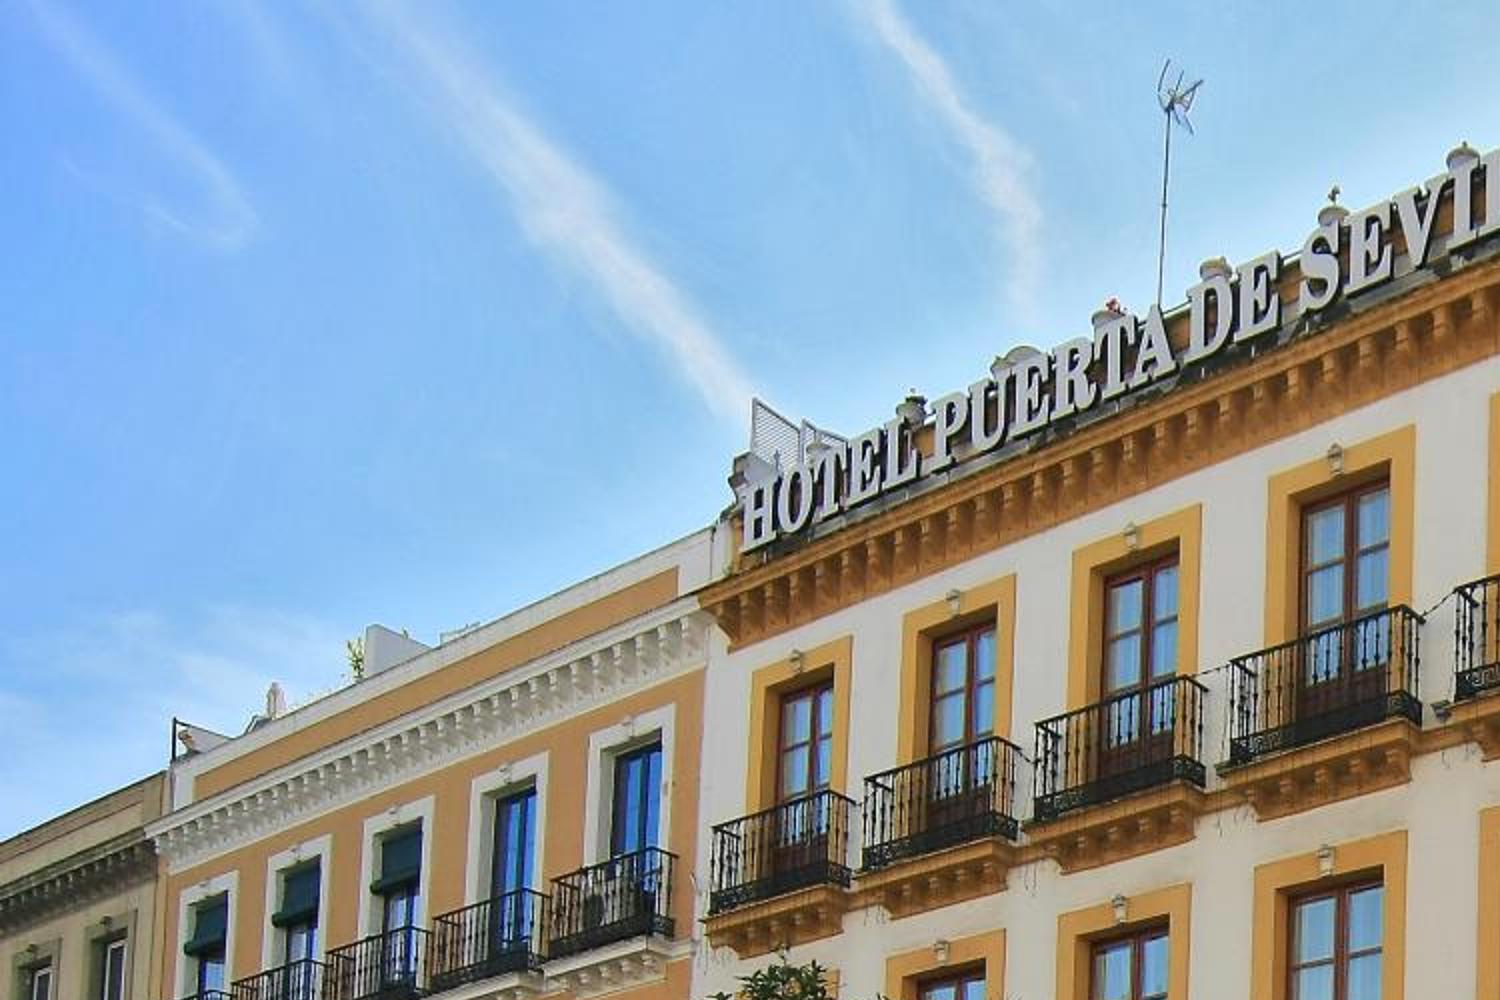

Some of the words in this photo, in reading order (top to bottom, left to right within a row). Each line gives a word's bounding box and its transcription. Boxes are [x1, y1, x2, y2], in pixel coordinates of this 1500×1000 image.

[739, 418, 917, 554] HOTEL
[921, 304, 1180, 475] PUERTA
[1182, 249, 1282, 367] DE
